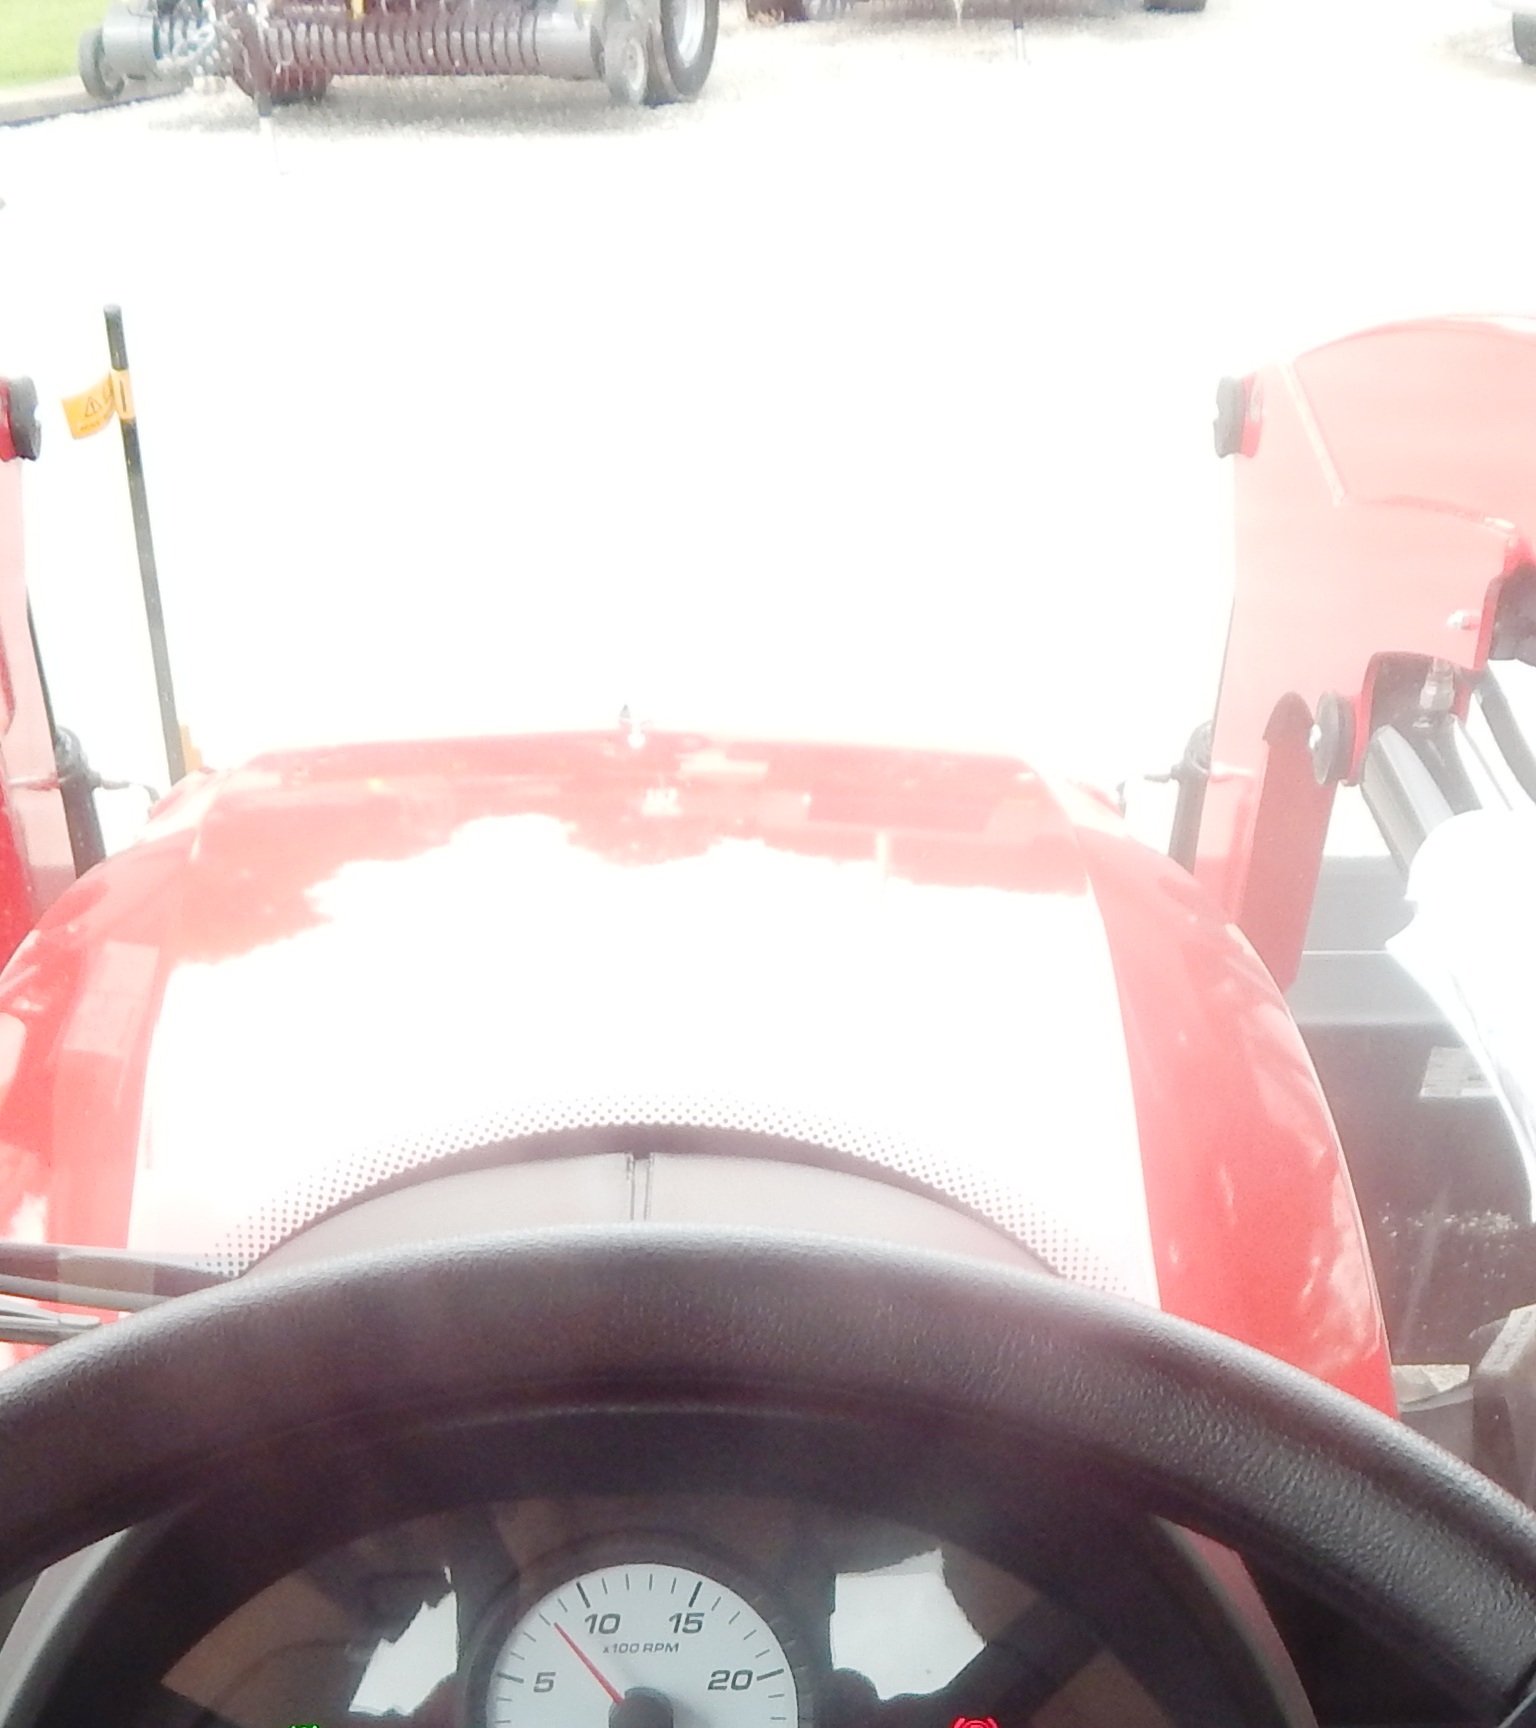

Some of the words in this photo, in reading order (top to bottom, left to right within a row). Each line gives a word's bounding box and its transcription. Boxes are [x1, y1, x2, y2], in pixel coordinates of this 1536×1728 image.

[584, 1613, 620, 1634] 10
[668, 1612, 705, 1634] 15
[642, 1642, 680, 1654] RPM
[533, 1671, 556, 1693] 5
[707, 1670, 753, 1690] 20
